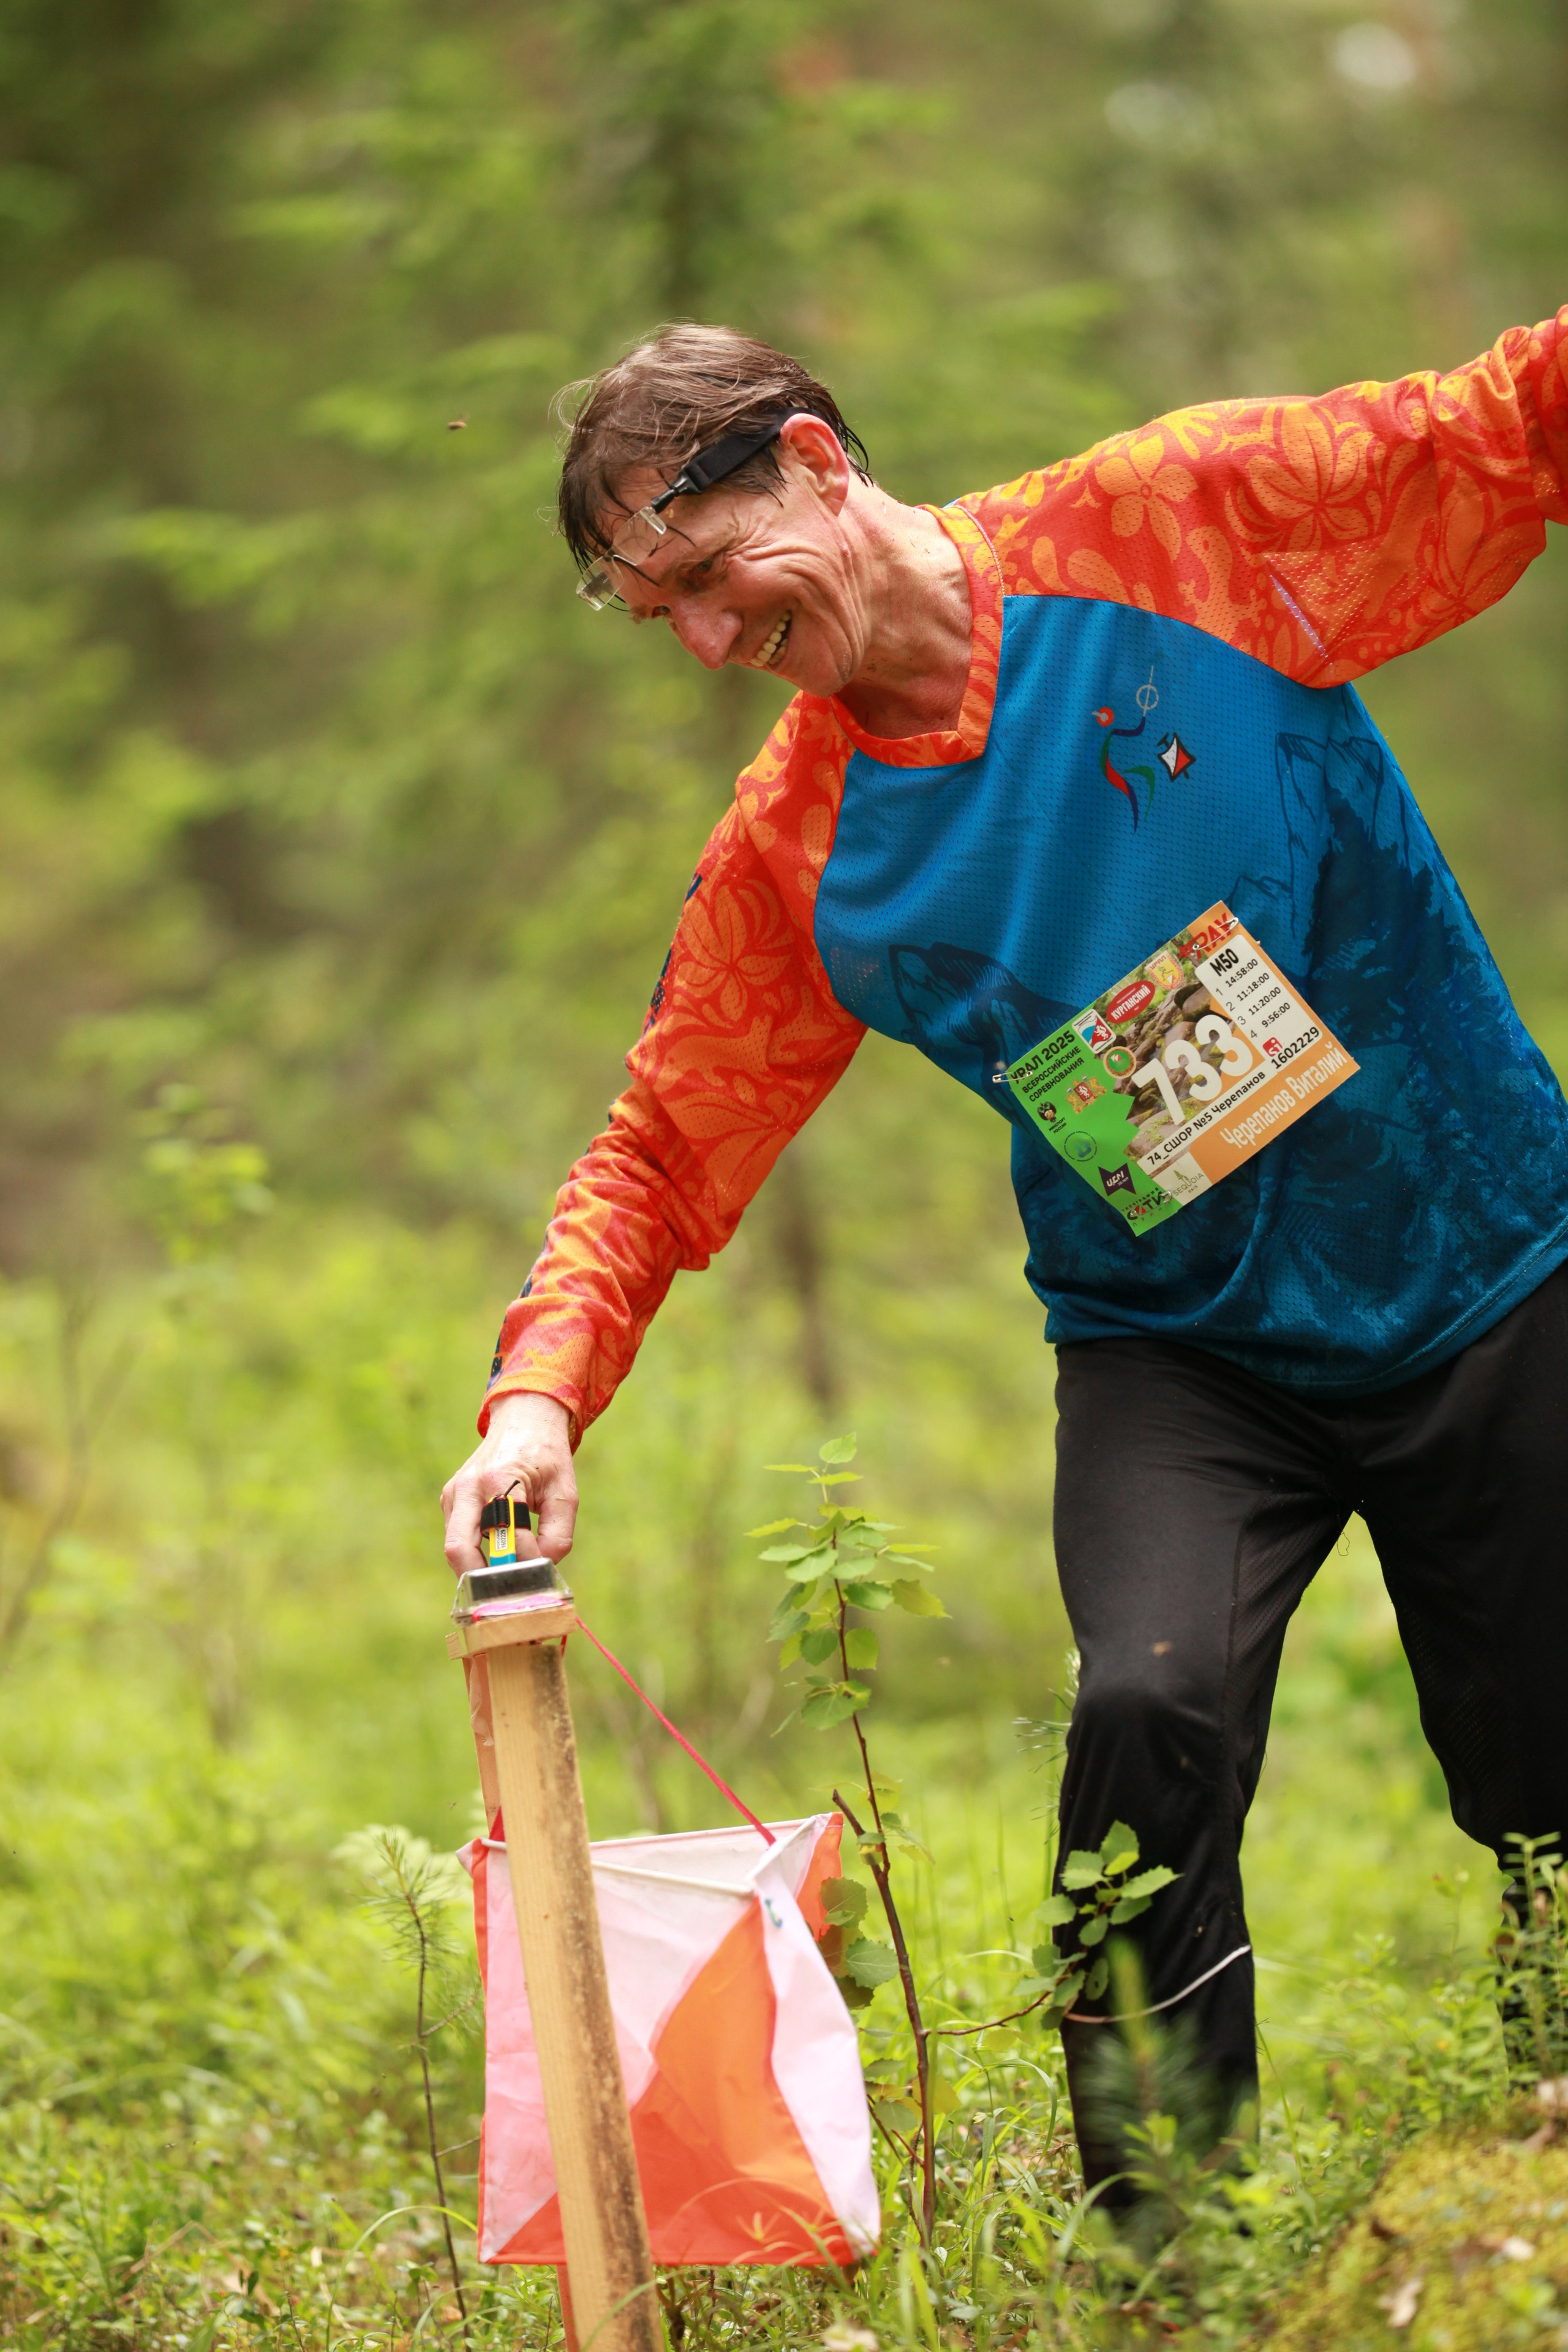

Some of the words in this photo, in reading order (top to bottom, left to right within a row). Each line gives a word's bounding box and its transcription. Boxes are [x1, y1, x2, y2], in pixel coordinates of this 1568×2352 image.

[1225, 959, 1258, 987] 14:58:00
[1226, 1001, 1235, 1011] 2
[1237, 973, 1270, 1001] 11:18:00
[1110, 984, 1151, 1020] КУРГАНСКИЙ
[1237, 1016, 1246, 1025] 3
[1248, 986, 1281, 1016] 11:20:00
[1250, 1030, 1257, 1038] 4
[1261, 1002, 1291, 1028] 9:56:00
[1011, 1055, 1044, 1084] УРАЛ
[1041, 1030, 1075, 1060] 2025
[1271, 1026, 1319, 1069] 1602229
[1022, 1046, 1081, 1093] ВСЕРОССИЙСКИЕ
[1029, 1057, 1084, 1102] СОРЕВНОВАНИЯ
[1131, 1014, 1253, 1126] 733
[1193, 1112, 1213, 1131] №5
[1211, 1071, 1266, 1114] Черепанов
[1219, 1088, 1296, 1149] Черепанов
[1285, 1041, 1348, 1100] Виталий
[1053, 1122, 1066, 1134] РОССИИ
[1121, 1187, 1159, 1213] ТИПОГРАФИЯ
[1173, 1172, 1205, 1196] SEQUOIA
